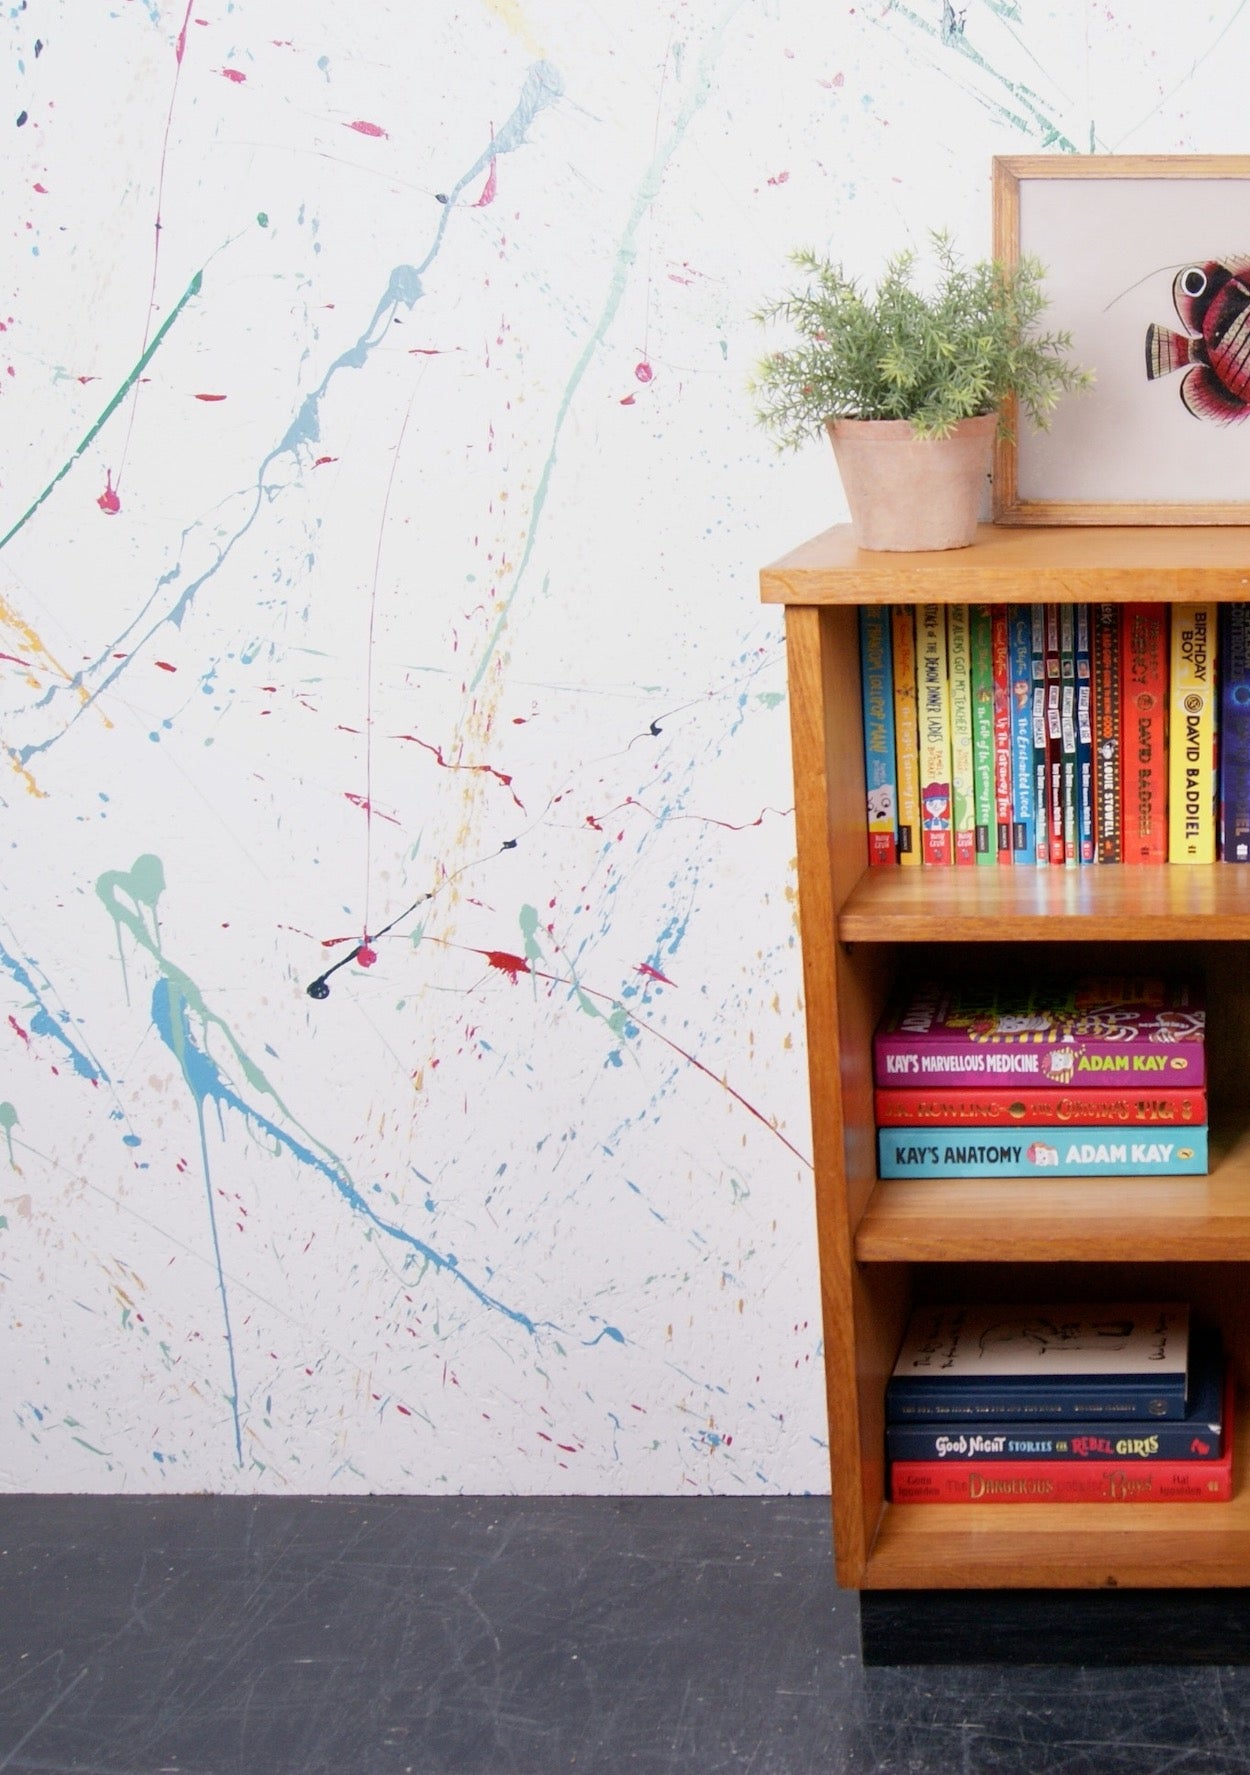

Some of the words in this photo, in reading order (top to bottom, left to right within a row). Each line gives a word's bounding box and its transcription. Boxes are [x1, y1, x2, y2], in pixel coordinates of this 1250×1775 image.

[952, 625, 967, 654] ALIENS
[1181, 630, 1193, 663] BOY
[1194, 612, 1207, 682] BIRTHDAY
[924, 657, 940, 683] DEMON
[954, 657, 967, 676] GOT
[925, 685, 943, 713] DINNER
[955, 679, 967, 692] MY
[954, 696, 969, 735] TEACHER!
[926, 716, 944, 743] LADIES
[1139, 717, 1152, 763] DAVID
[1186, 715, 1200, 762] DAVID
[1103, 761, 1113, 790] LOUIE
[998, 797, 1011, 818] Tree
[1104, 792, 1114, 838] STOWELL
[1138, 768, 1152, 838] BADDIEL
[1185, 768, 1200, 839] BADDIEL
[886, 1054, 920, 1073] KAY'S
[921, 1054, 985, 1072] MARVELLOUS
[986, 1054, 1039, 1073] MEDICINE
[1078, 1055, 1129, 1071] ADAM
[1133, 1055, 1168, 1071] KAY
[917, 1102, 1000, 1118] ROWLING
[1134, 1100, 1175, 1120] PIG
[895, 1146, 940, 1165] KAY'S
[944, 1146, 1022, 1164] ANATOMY
[1065, 1144, 1127, 1164] ADAM
[1131, 1143, 1174, 1163] KAY
[1008, 1440, 1053, 1452] STORIES
[1071, 1435, 1114, 1457] REBEL
[1115, 1434, 1159, 1457] GIRLS
[969, 1472, 1053, 1499] DANGEROUS
